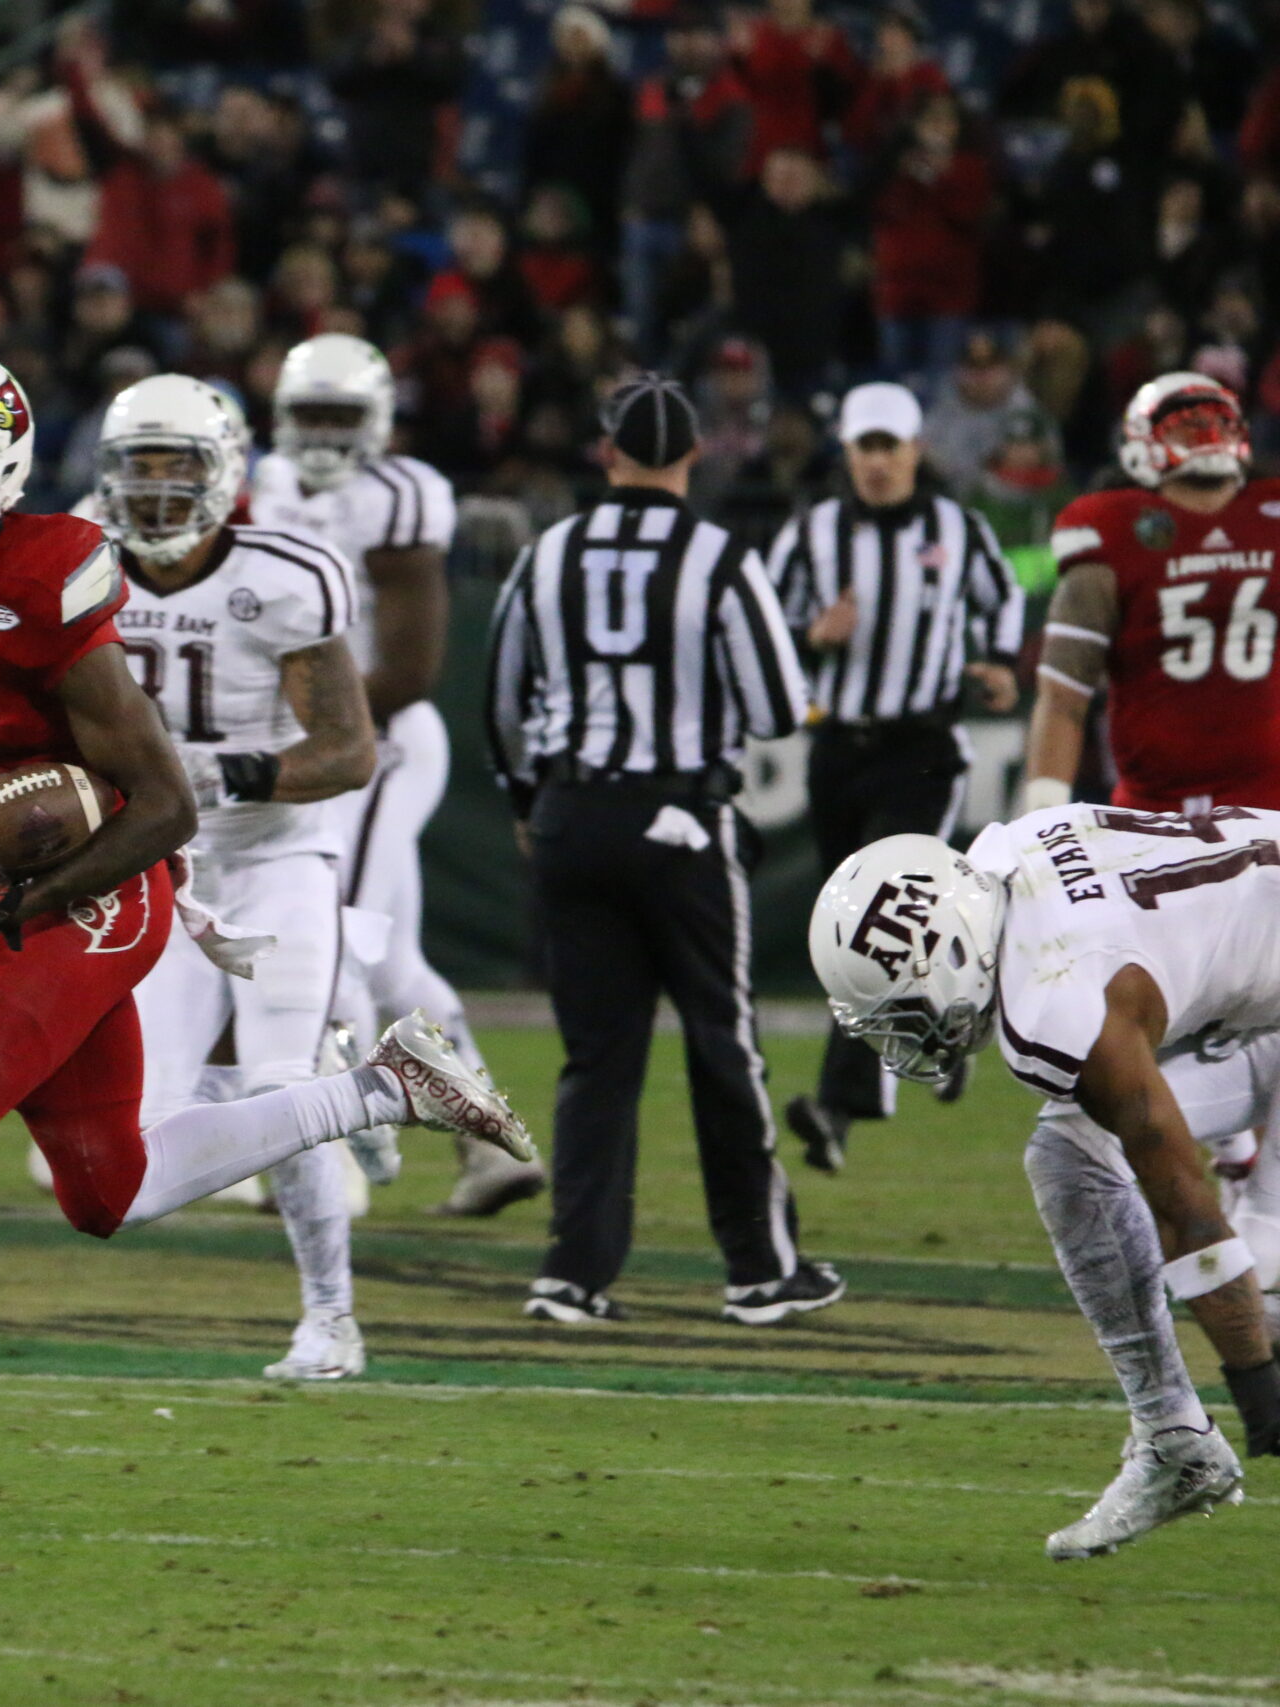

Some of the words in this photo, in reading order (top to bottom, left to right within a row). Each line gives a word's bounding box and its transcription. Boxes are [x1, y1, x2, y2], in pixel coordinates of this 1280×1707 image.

[118, 610, 166, 629] EXAS
[581, 549, 659, 655] U
[1158, 576, 1277, 682] 56
[1036, 822, 1106, 904] EVANS
[400, 1058, 502, 1137] adizero
